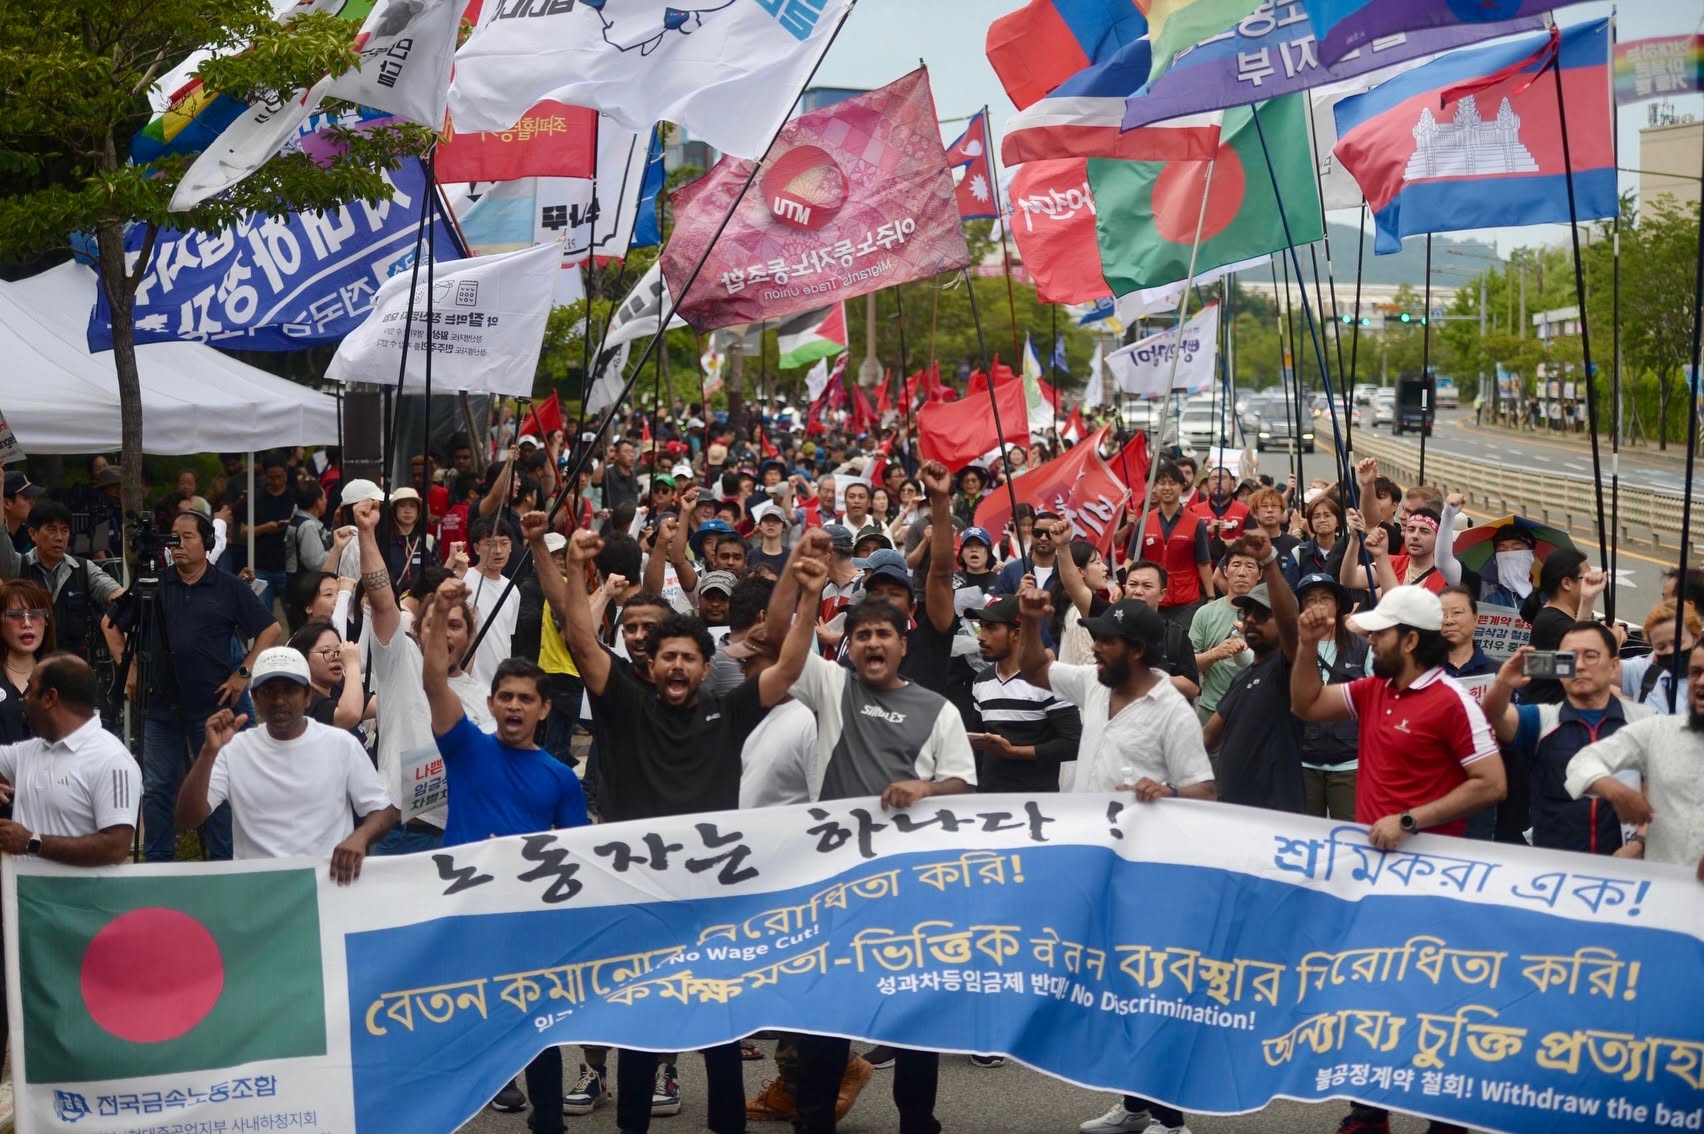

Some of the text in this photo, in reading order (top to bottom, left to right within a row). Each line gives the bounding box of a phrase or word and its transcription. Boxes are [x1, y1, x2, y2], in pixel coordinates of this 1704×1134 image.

[1474, 627, 1509, 639] 금삭감
[1478, 614, 1512, 626] 쁜계약
[1507, 642, 1527, 653] 중
[1469, 684, 1487, 699] 회!
[415, 758, 443, 781] 나쁜
[431, 800, 1124, 904] 노동자는 하나다 !
[1511, 871, 1652, 917] এক!
[366, 978, 488, 1037] বেতন
[911, 850, 1026, 892] করি!
[669, 923, 820, 966] No Wage Cut!
[1520, 945, 1641, 1001] করি!
[876, 969, 1257, 1031] 성과차등임금제 반대! No Discrimination!
[97, 1075, 277, 1116] 전국금속노동조합
[1316, 1062, 1703, 1130] 불공정계약 철회! Withdraw the bad
[231, 1110, 318, 1132] 사내하청지회
